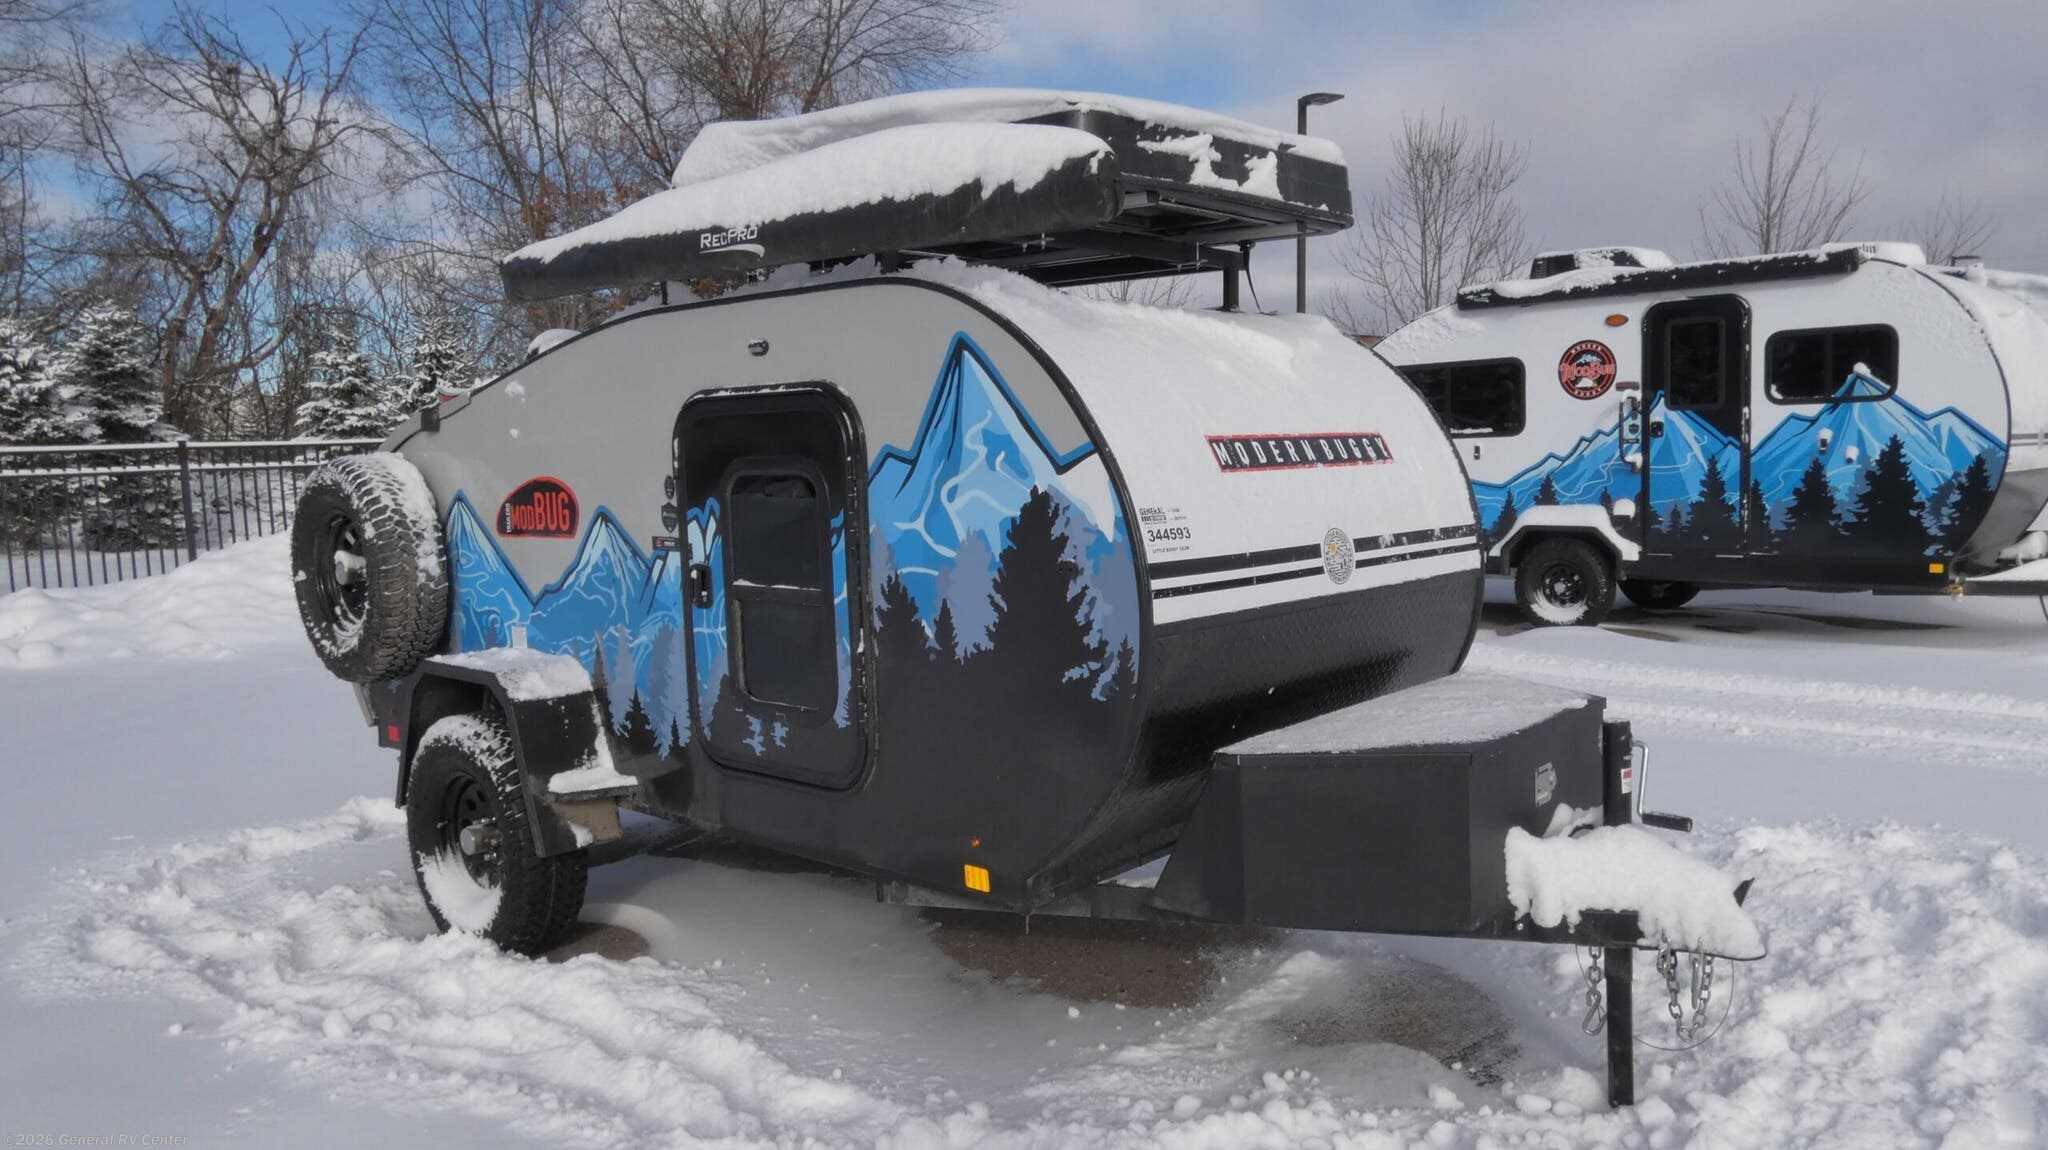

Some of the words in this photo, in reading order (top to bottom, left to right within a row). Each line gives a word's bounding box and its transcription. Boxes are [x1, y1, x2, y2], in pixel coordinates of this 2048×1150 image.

[1211, 438, 1318, 468] MODERN
[1318, 436, 1389, 461] BUGGY
[1147, 527, 1191, 542] 344593
